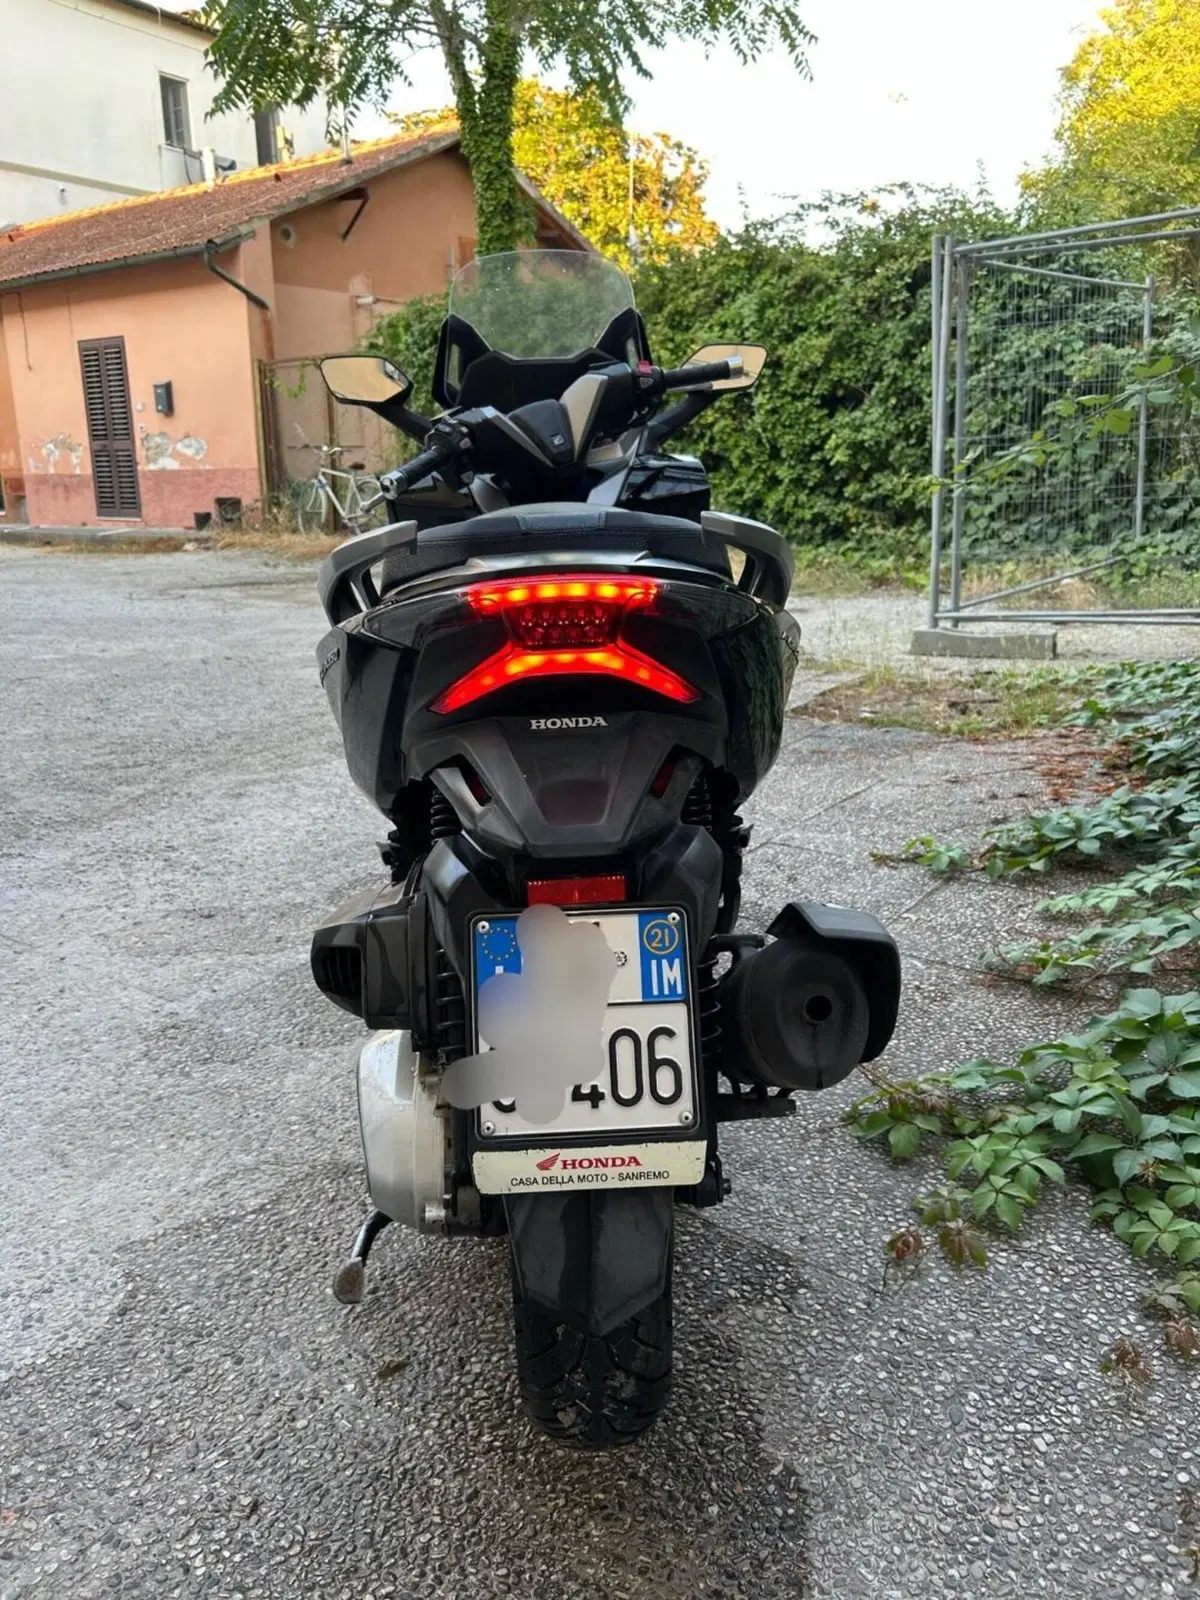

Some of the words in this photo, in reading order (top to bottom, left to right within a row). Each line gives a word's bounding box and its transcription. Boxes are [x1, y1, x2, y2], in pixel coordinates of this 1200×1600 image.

[530, 716, 608, 729] HONDA
[650, 928, 670, 948] 21
[651, 958, 682, 995] IM
[561, 1155, 642, 1170] HONDA
[511, 1177, 539, 1186] CASA
[541, 1174, 574, 1185] DELLA
[577, 1173, 608, 1183] MOTO
[618, 1170, 669, 1182] SANREMO
